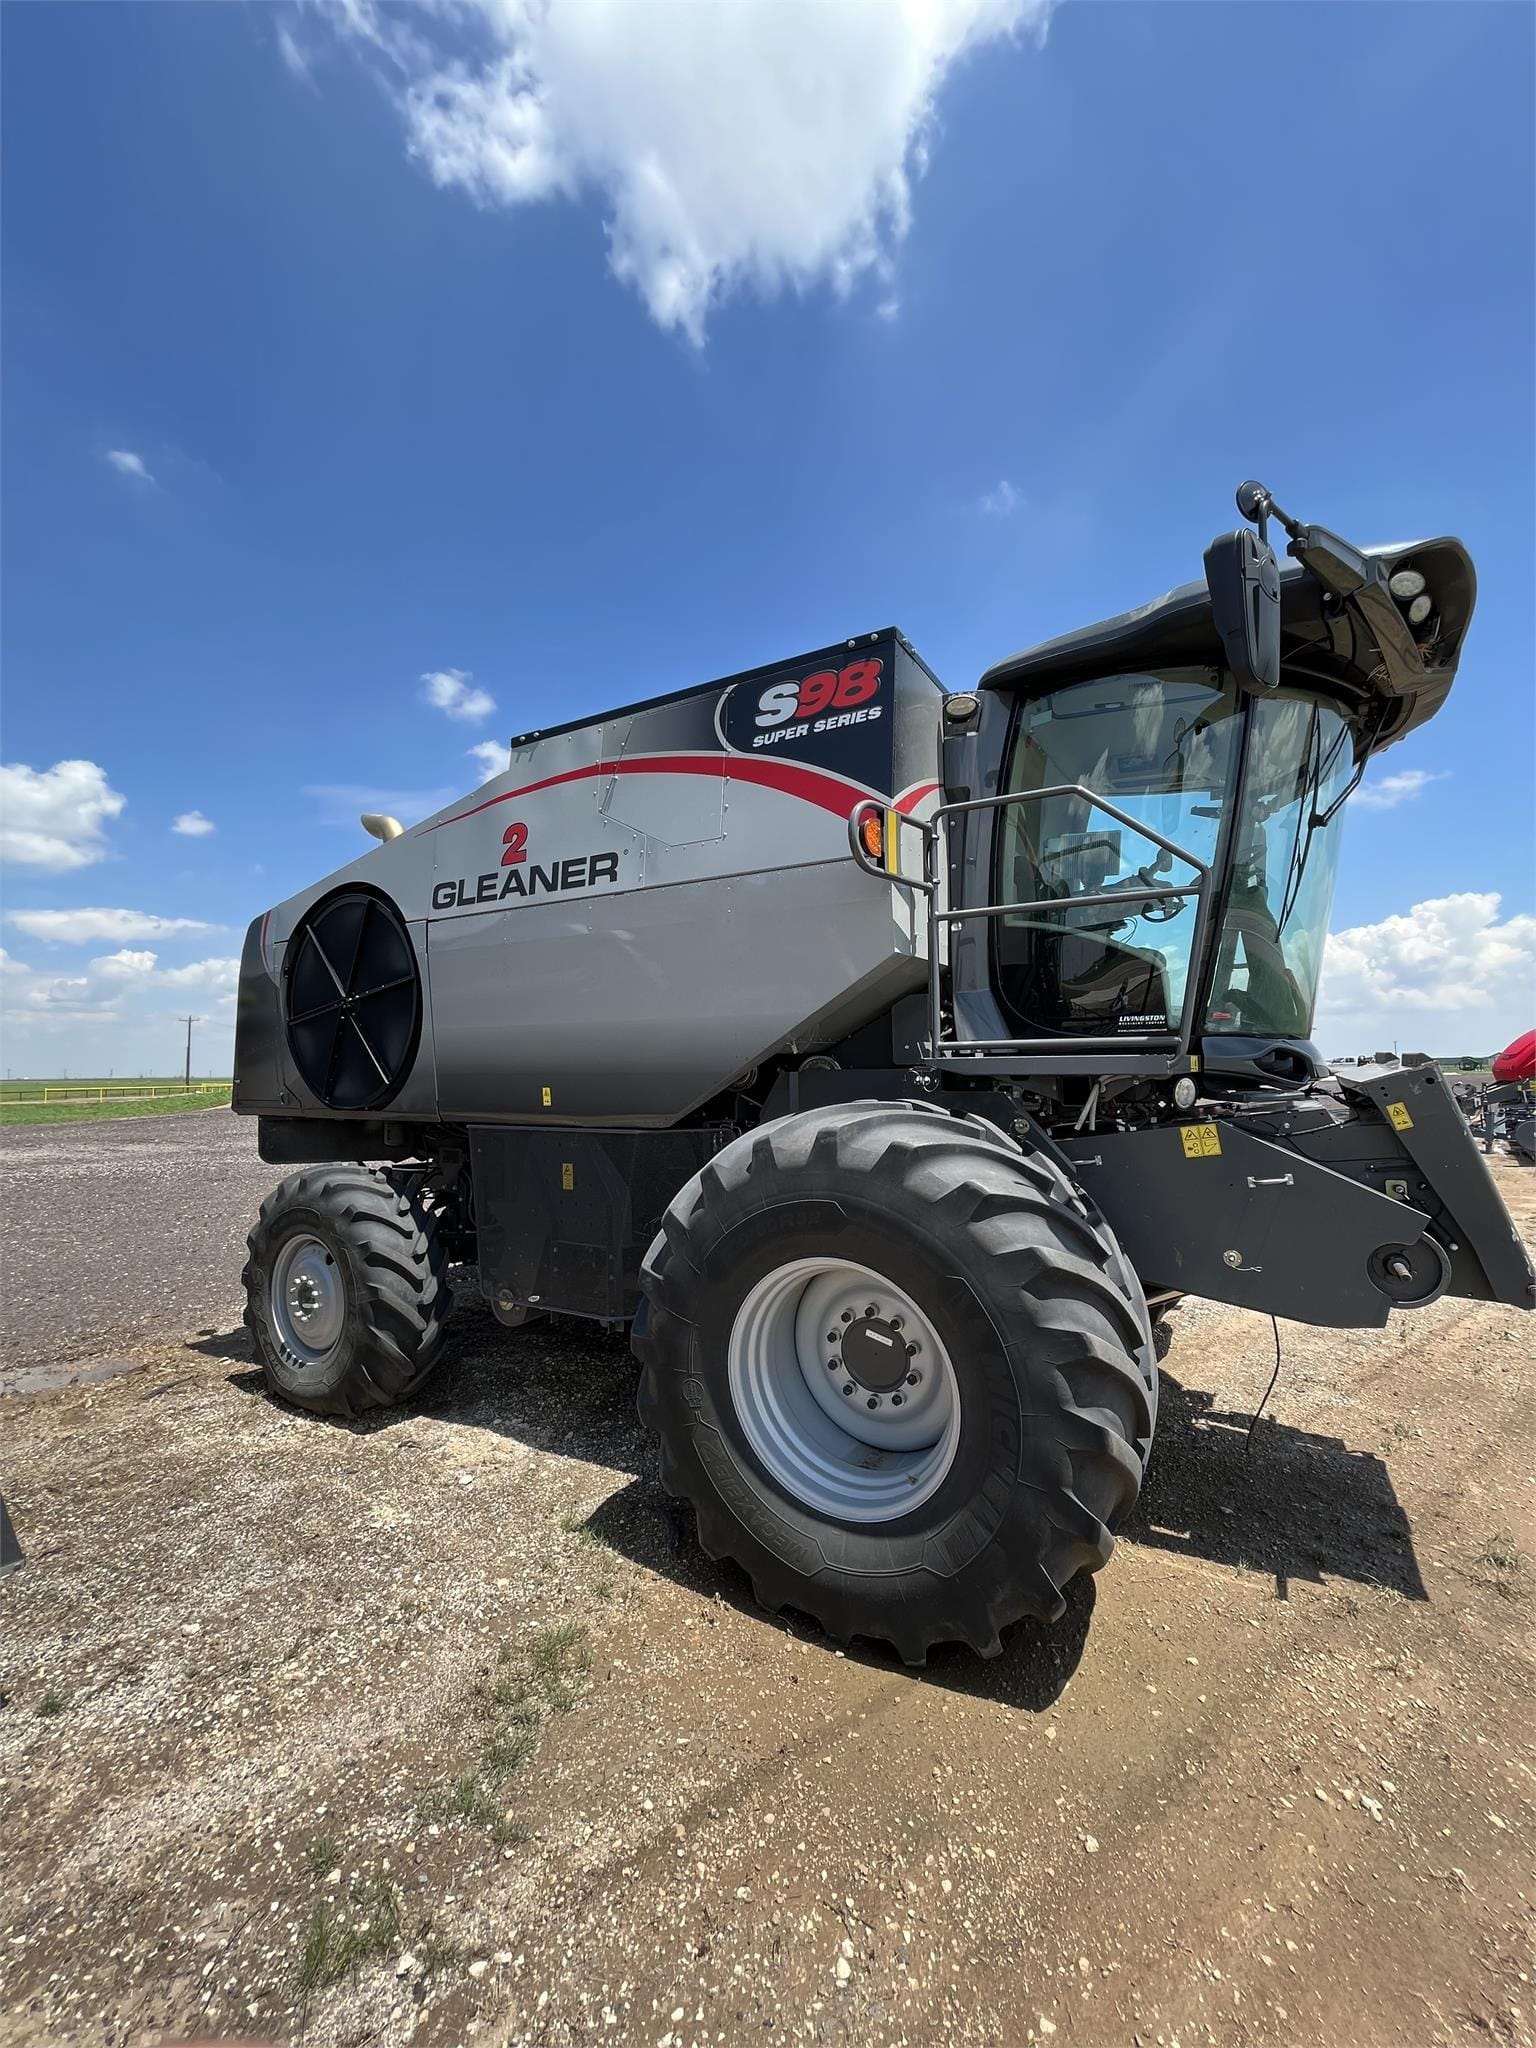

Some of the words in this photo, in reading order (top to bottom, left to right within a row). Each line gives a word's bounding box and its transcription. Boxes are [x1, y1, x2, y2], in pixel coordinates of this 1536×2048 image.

[755, 657, 885, 727] S98
[752, 724, 809, 748] SUPER
[813, 706, 884, 733] SERIES
[500, 822, 529, 867] 2
[432, 851, 619, 910] GLEANER
[1119, 1014, 1166, 1022] LIVINGSTON
